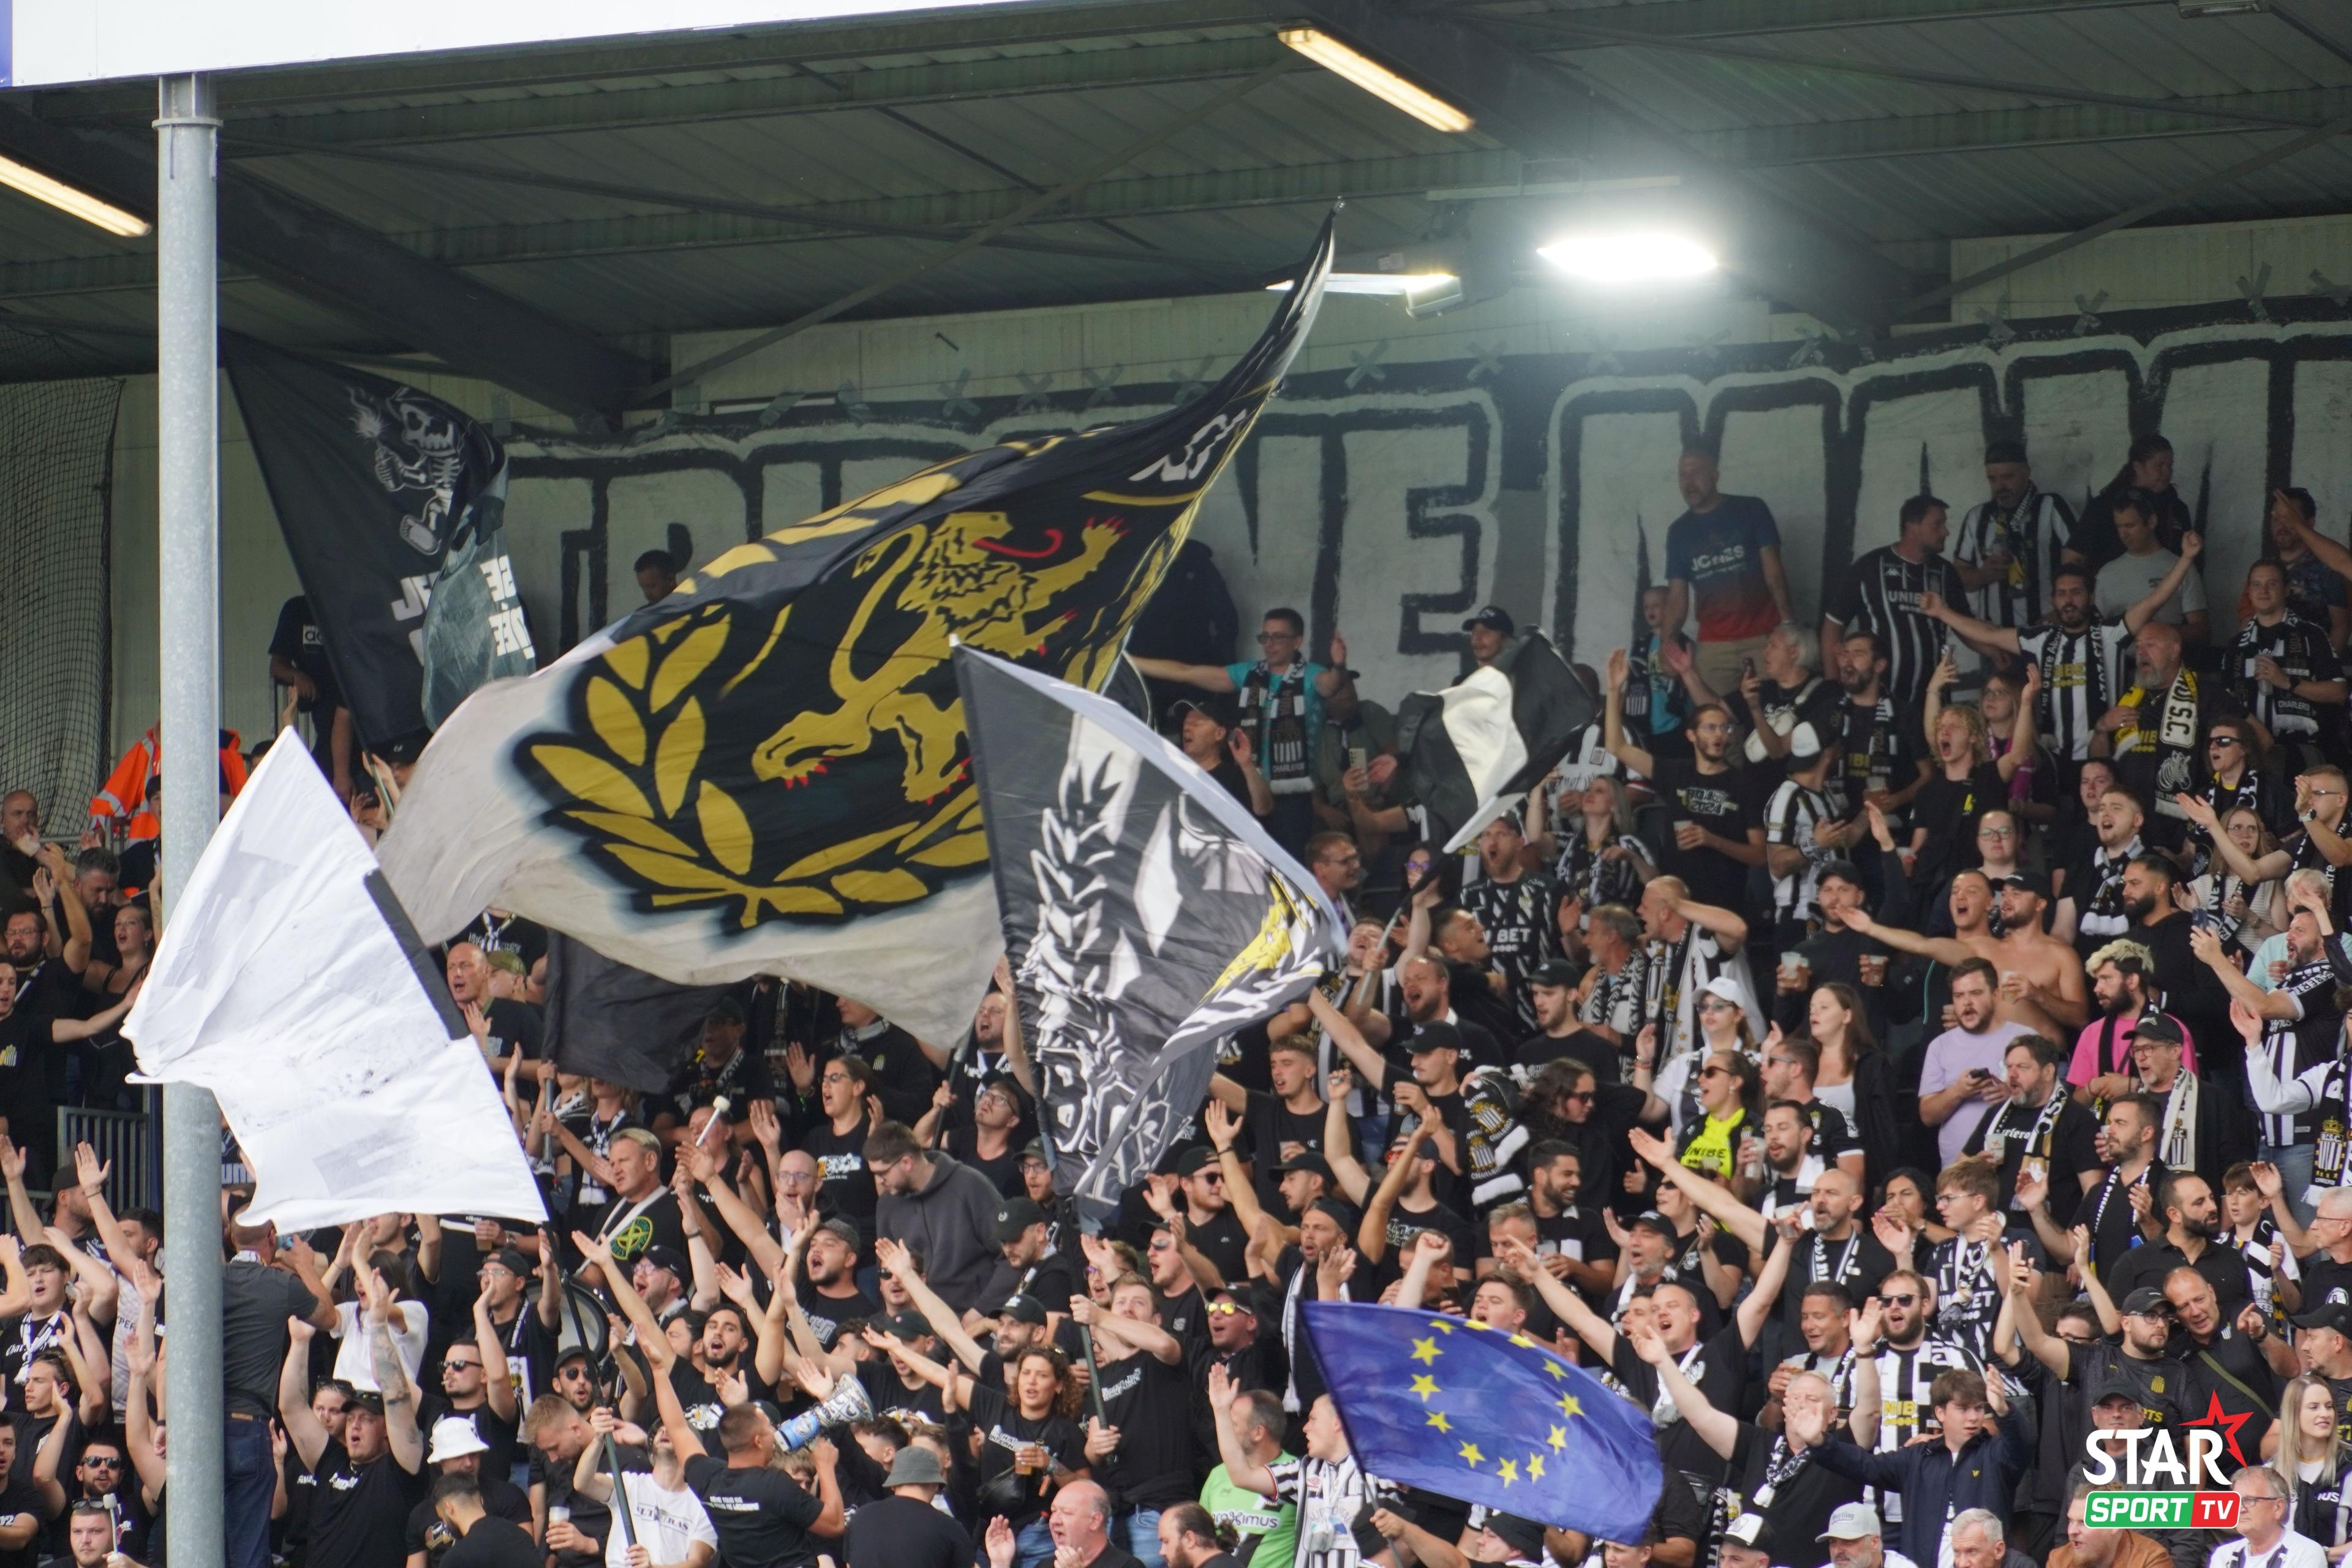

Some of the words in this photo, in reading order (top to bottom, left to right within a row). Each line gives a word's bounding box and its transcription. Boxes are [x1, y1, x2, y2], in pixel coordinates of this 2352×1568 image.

[2165, 704, 2194, 737] S.C.
[1497, 929, 1531, 943] BET
[1938, 1291, 1996, 1311] UNET
[1883, 1399, 1917, 1416] NIB
